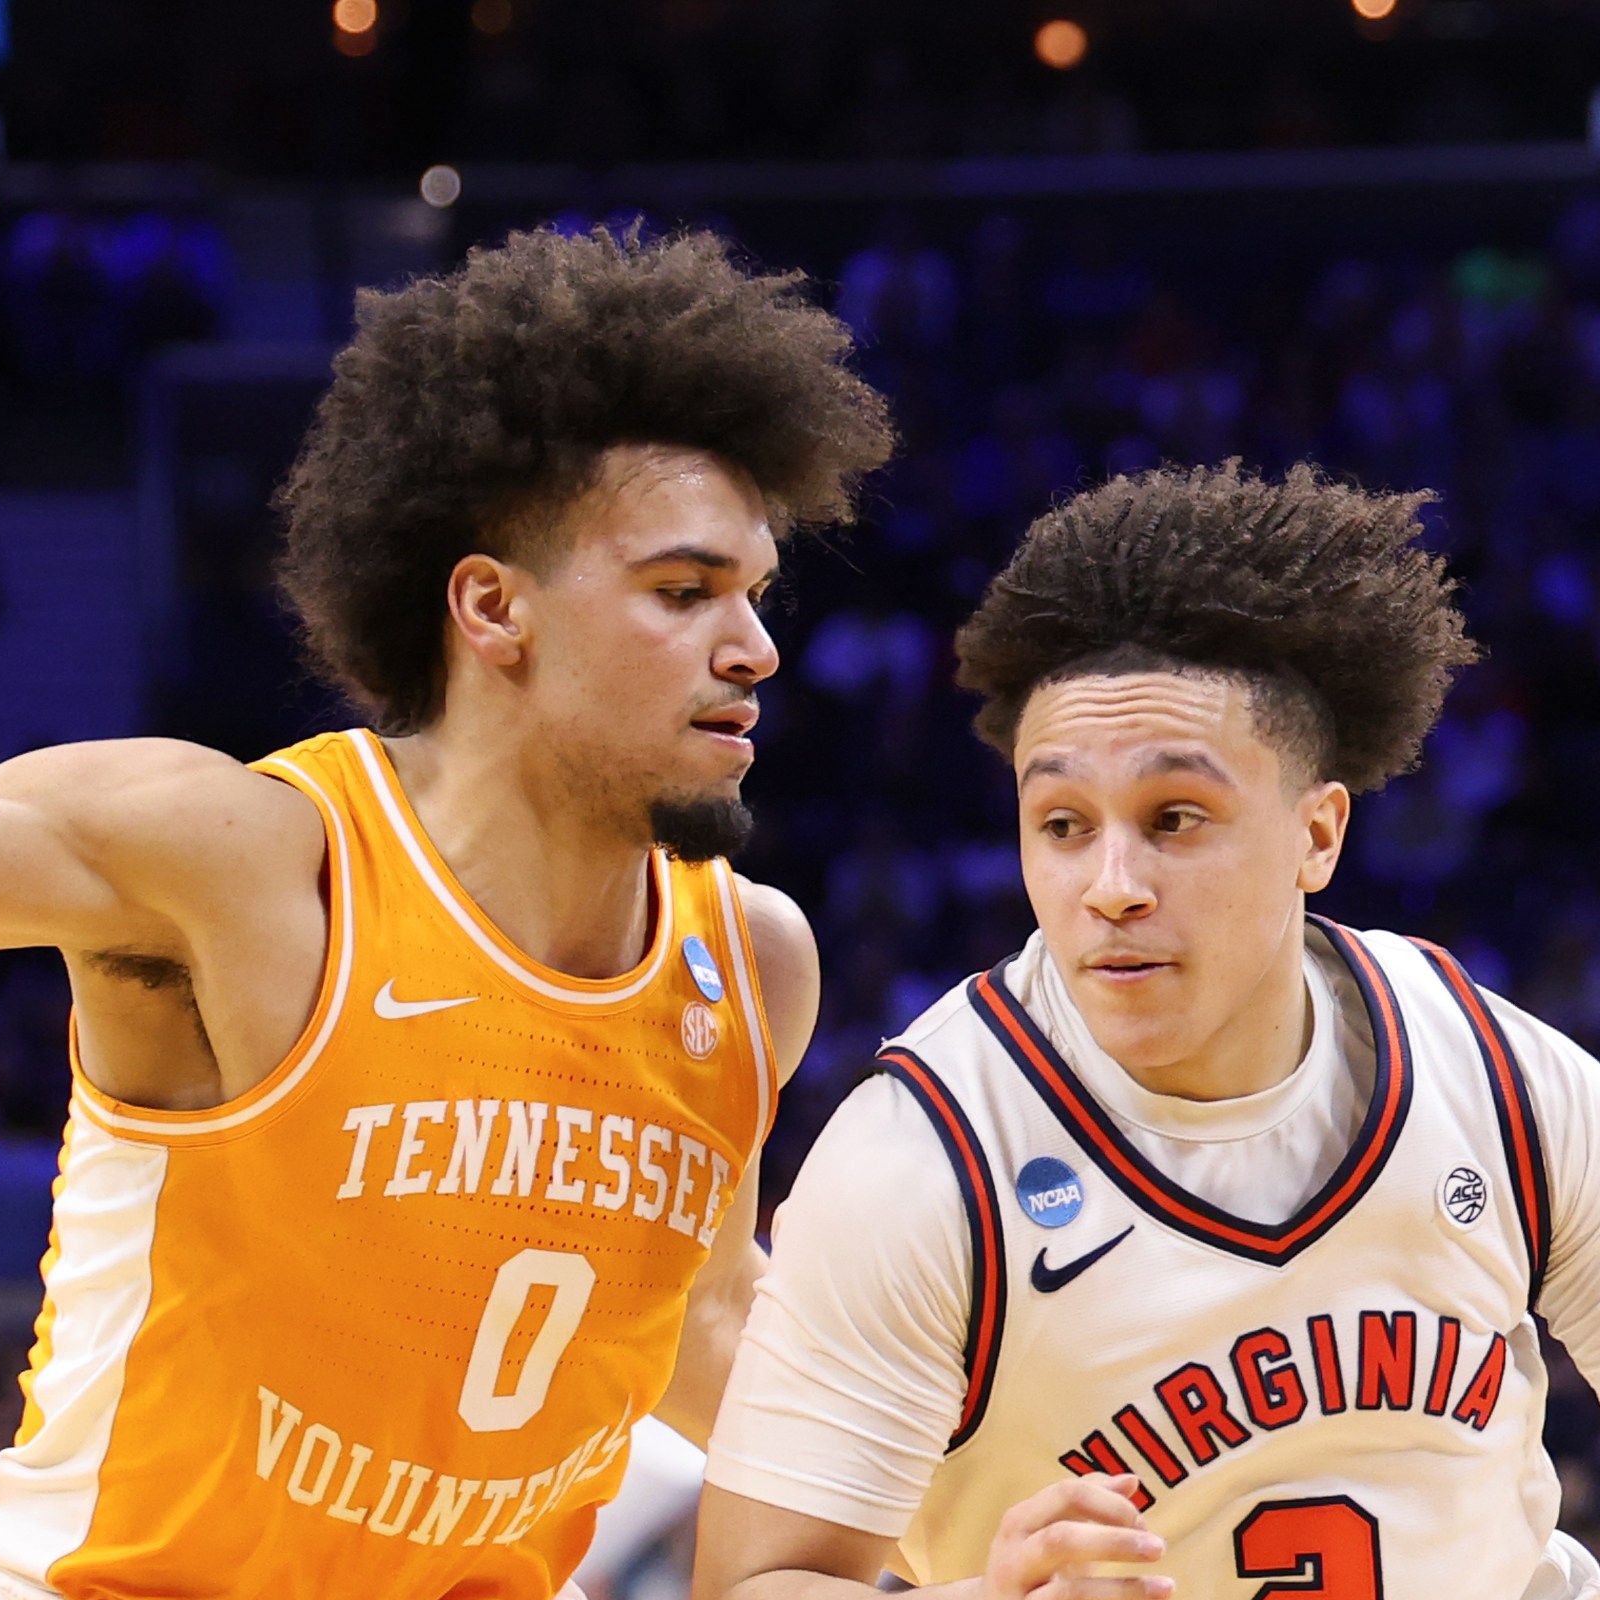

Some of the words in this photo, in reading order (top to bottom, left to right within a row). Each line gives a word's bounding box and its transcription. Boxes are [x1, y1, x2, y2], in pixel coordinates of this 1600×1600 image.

[684, 1005, 717, 1055] SEC
[336, 1099, 730, 1249] TENNESSEE
[1027, 1183, 1082, 1214] NCAA
[1448, 1184, 1483, 1205] ACC
[457, 1247, 596, 1432] 0
